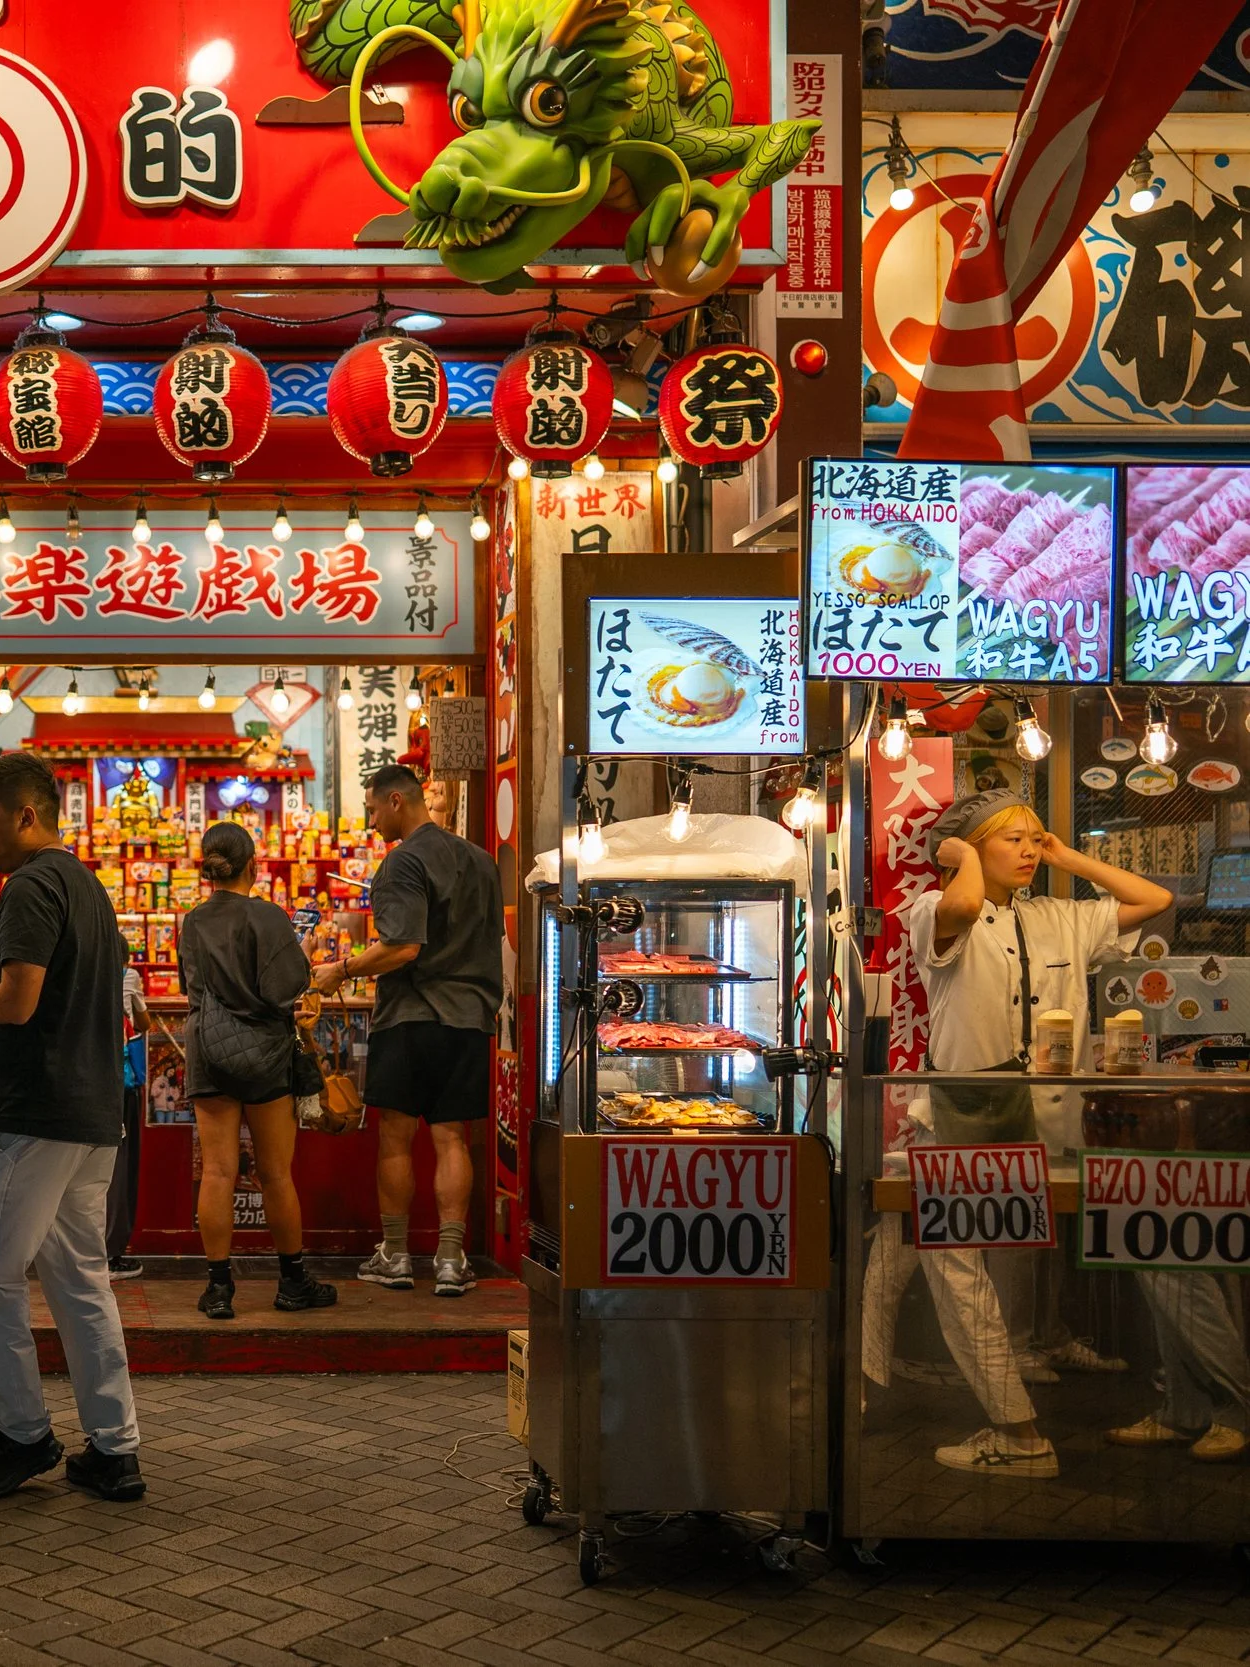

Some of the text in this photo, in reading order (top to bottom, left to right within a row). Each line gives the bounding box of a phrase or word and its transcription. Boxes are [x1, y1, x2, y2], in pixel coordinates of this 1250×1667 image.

[792, 62, 825, 176] 防犯カメ動中
[122, 88, 242, 205] 的
[13, 350, 58, 451] 秘宝館
[176, 350, 233, 450] 射的
[385, 340, 439, 434] 大当り
[530, 349, 587, 448] 射的
[686, 354, 775, 446] 祭
[536, 482, 648, 520] 新世界
[811, 465, 957, 503] 北海道産
[811, 503, 959, 523] from HOKKAIDO
[404, 536, 438, 634] 景品付
[813, 592, 951, 610] YESSO SCALLOP
[813, 608, 948, 654] ほたて
[969, 598, 1101, 640] WAGYU
[596, 608, 632, 744] ほたて
[759, 608, 787, 728] 北海道産
[788, 609, 801, 728] HOKKAIDO
[967, 640, 1101, 681] 和牛 A5
[453, 701, 473, 715] 500
[760, 729, 800, 745] from
[834, 920, 854, 933] Cas
[611, 1147, 789, 1209] WAGYU
[916, 1149, 1043, 1196] WAGYU
[1086, 1158, 1250, 1208] EZO SCALL
[233, 1192, 263, 1208] 万博
[919, 1195, 1048, 1243] 2000 YEN
[609, 1213, 786, 1277] 2000 YEN
[1085, 1209, 1250, 1263] 1000
